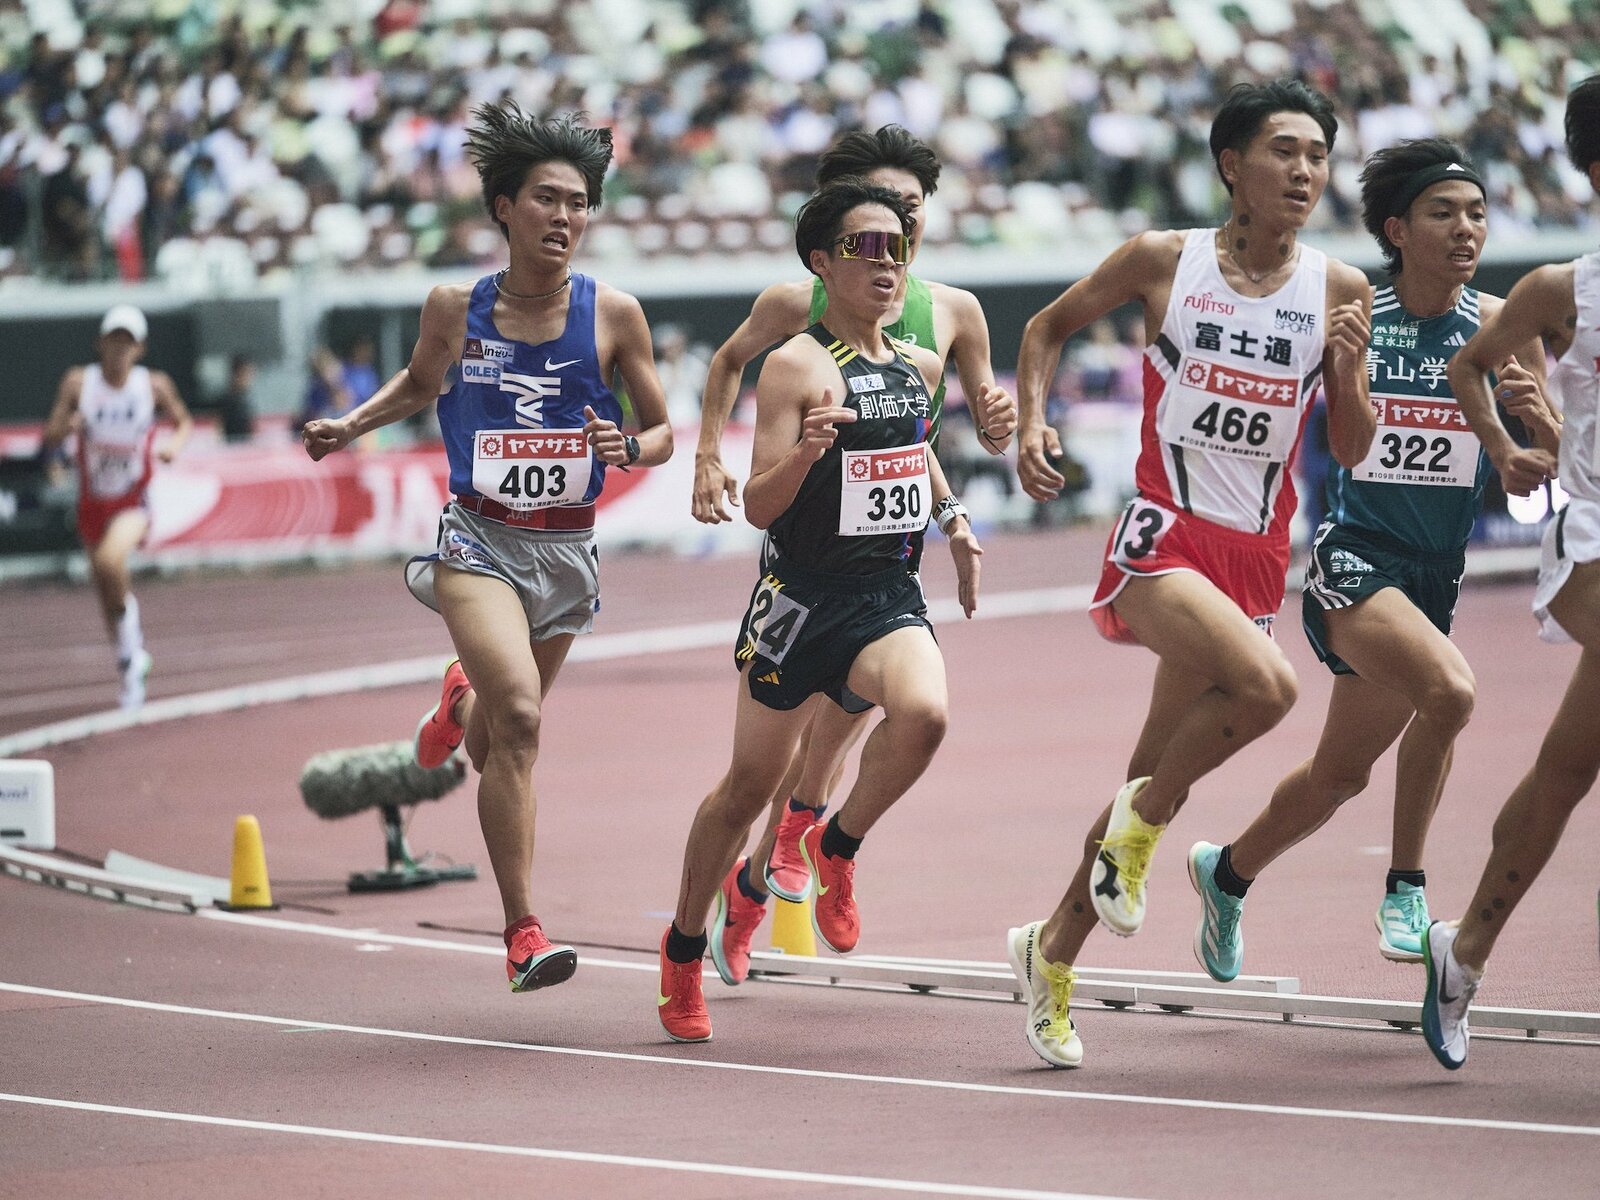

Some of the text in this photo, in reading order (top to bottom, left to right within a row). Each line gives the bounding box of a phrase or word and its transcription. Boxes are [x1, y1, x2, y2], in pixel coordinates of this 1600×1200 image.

[1184, 294, 1235, 315] FUJITSU
[1275, 308, 1316, 325] MOVE
[1274, 320, 1315, 336] SPORT
[1195, 322, 1292, 367] 富士通
[1385, 336, 1416, 349] 水上村
[464, 365, 501, 379] OILES
[1214, 371, 1294, 402] ヤマザキ
[858, 392, 930, 420] 創価大学
[1192, 401, 1272, 446] 466
[507, 437, 583, 454] ヤマザキ
[1379, 432, 1452, 473] 322
[875, 453, 924, 475] ヤマザキ
[499, 464, 567, 499] 403
[867, 483, 921, 522] 330
[749, 589, 801, 657] 24
